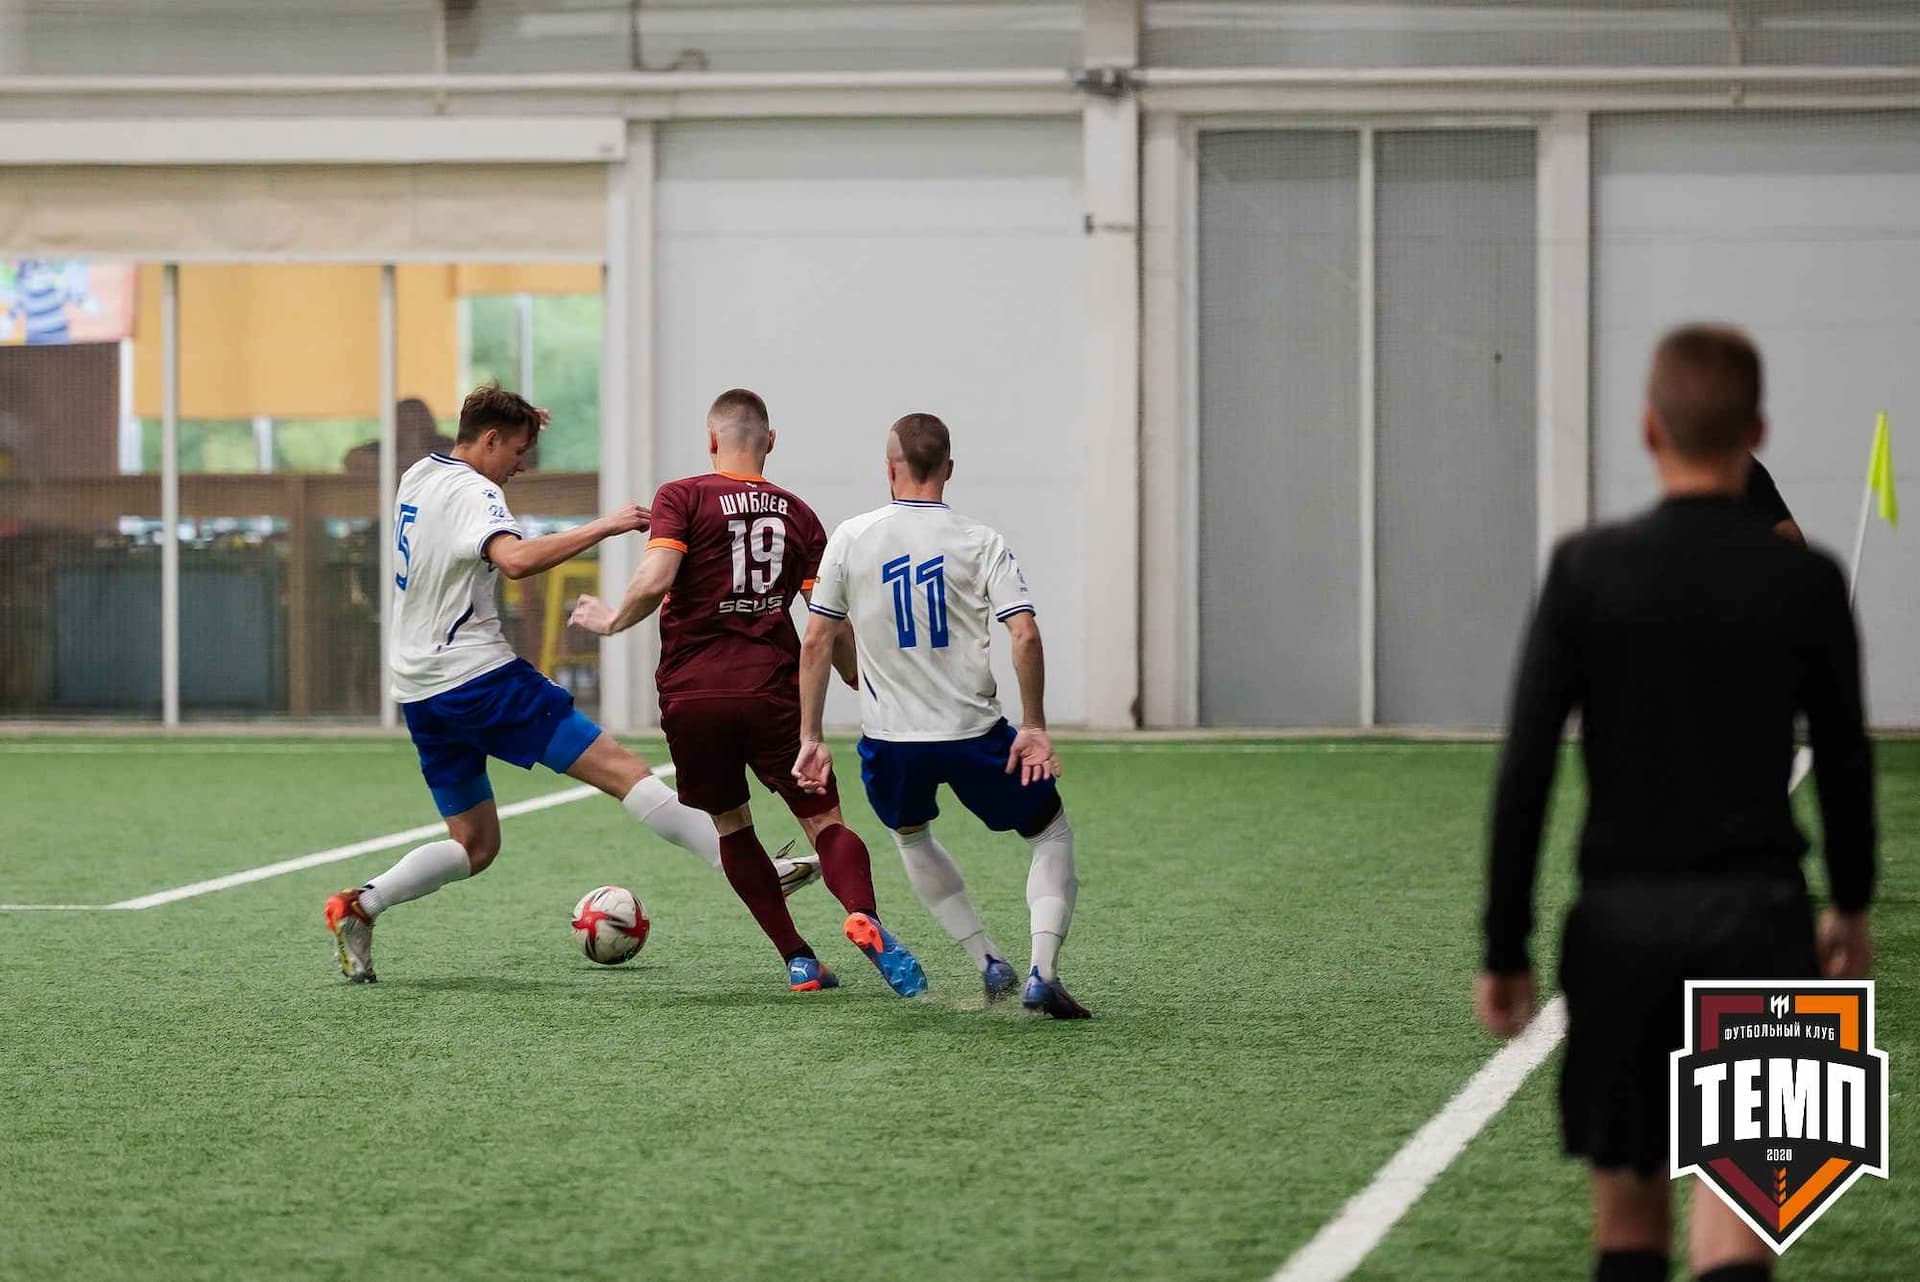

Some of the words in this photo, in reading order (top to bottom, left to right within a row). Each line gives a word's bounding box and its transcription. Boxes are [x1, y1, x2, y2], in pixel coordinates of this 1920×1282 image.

[395, 503, 419, 592] 5
[727, 516, 786, 594] 19
[718, 595, 784, 614] SEUS
[882, 554, 950, 649] 11
